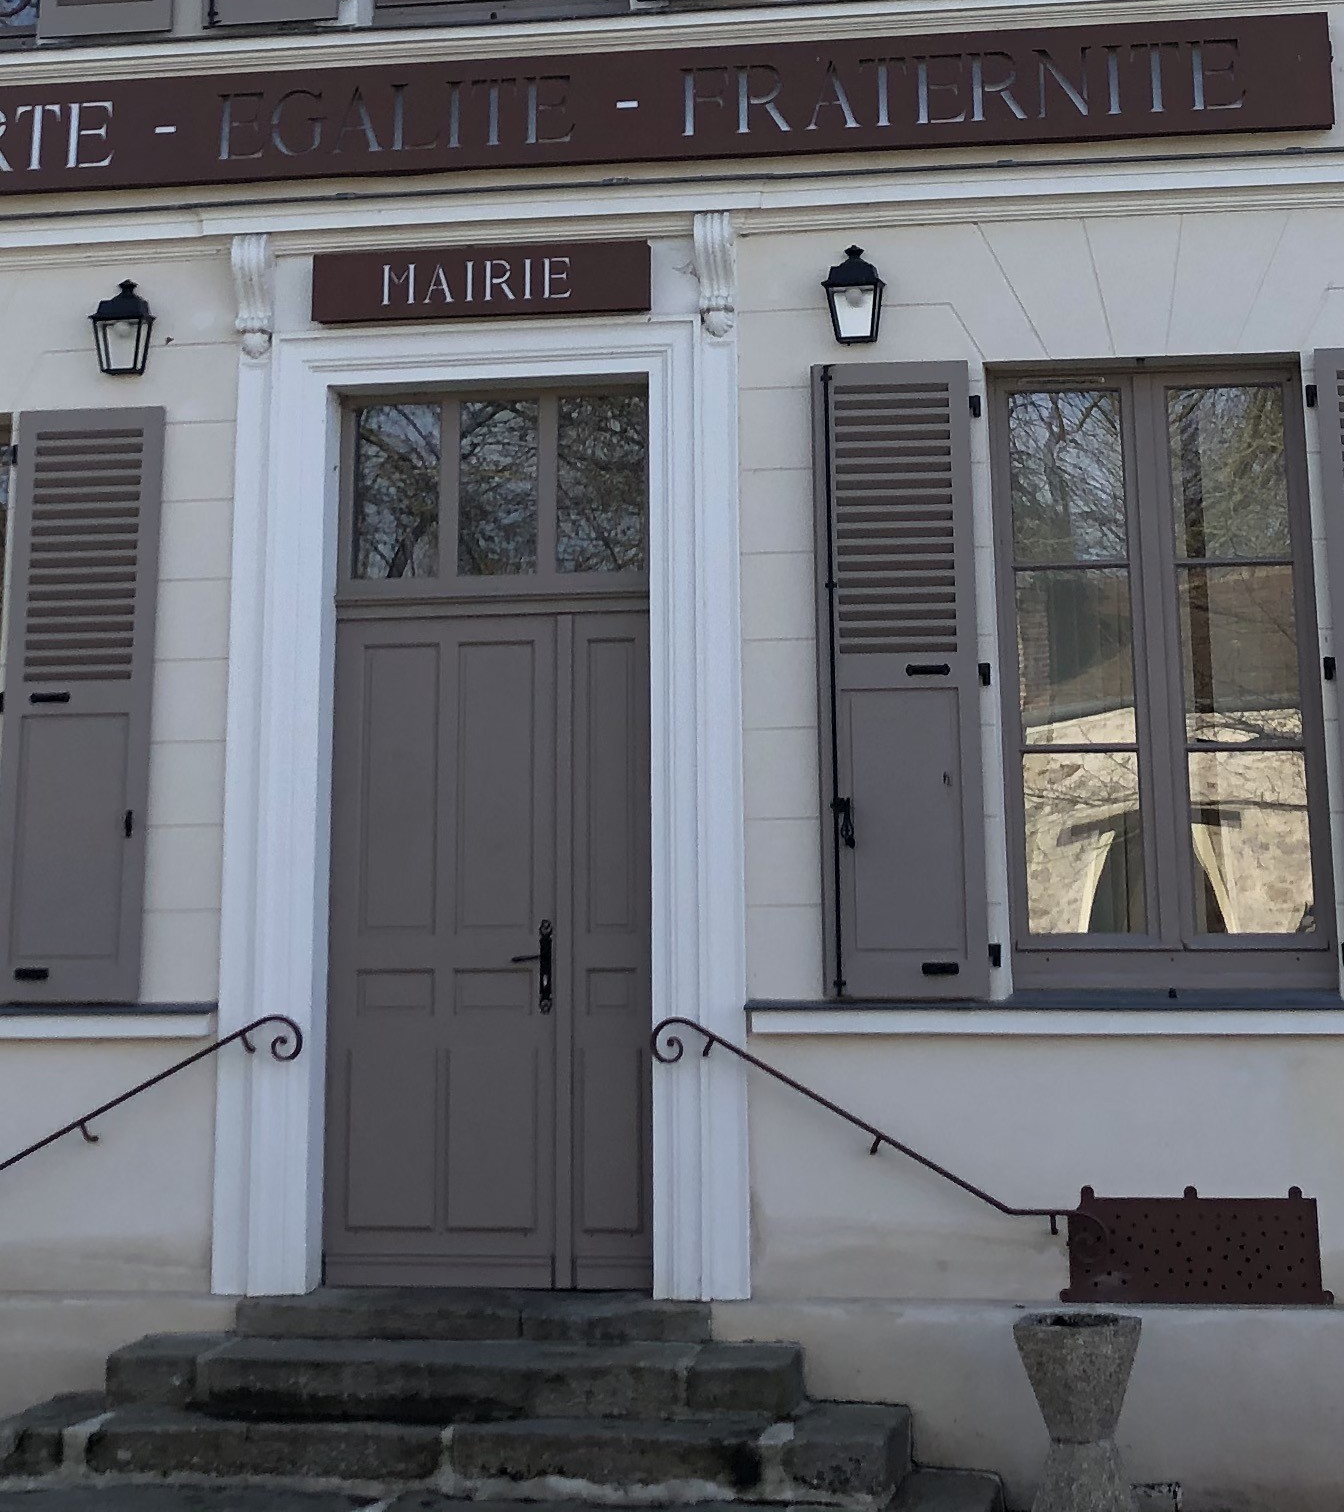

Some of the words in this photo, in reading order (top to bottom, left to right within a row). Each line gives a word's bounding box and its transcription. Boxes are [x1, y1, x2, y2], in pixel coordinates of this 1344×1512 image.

[154, 124, 177, 134] -
[217, 74, 576, 160] EGALITE
[615, 99, 639, 109] -
[679, 38, 1246, 136] FRATERNITE
[381, 256, 572, 306] MAIRIE
